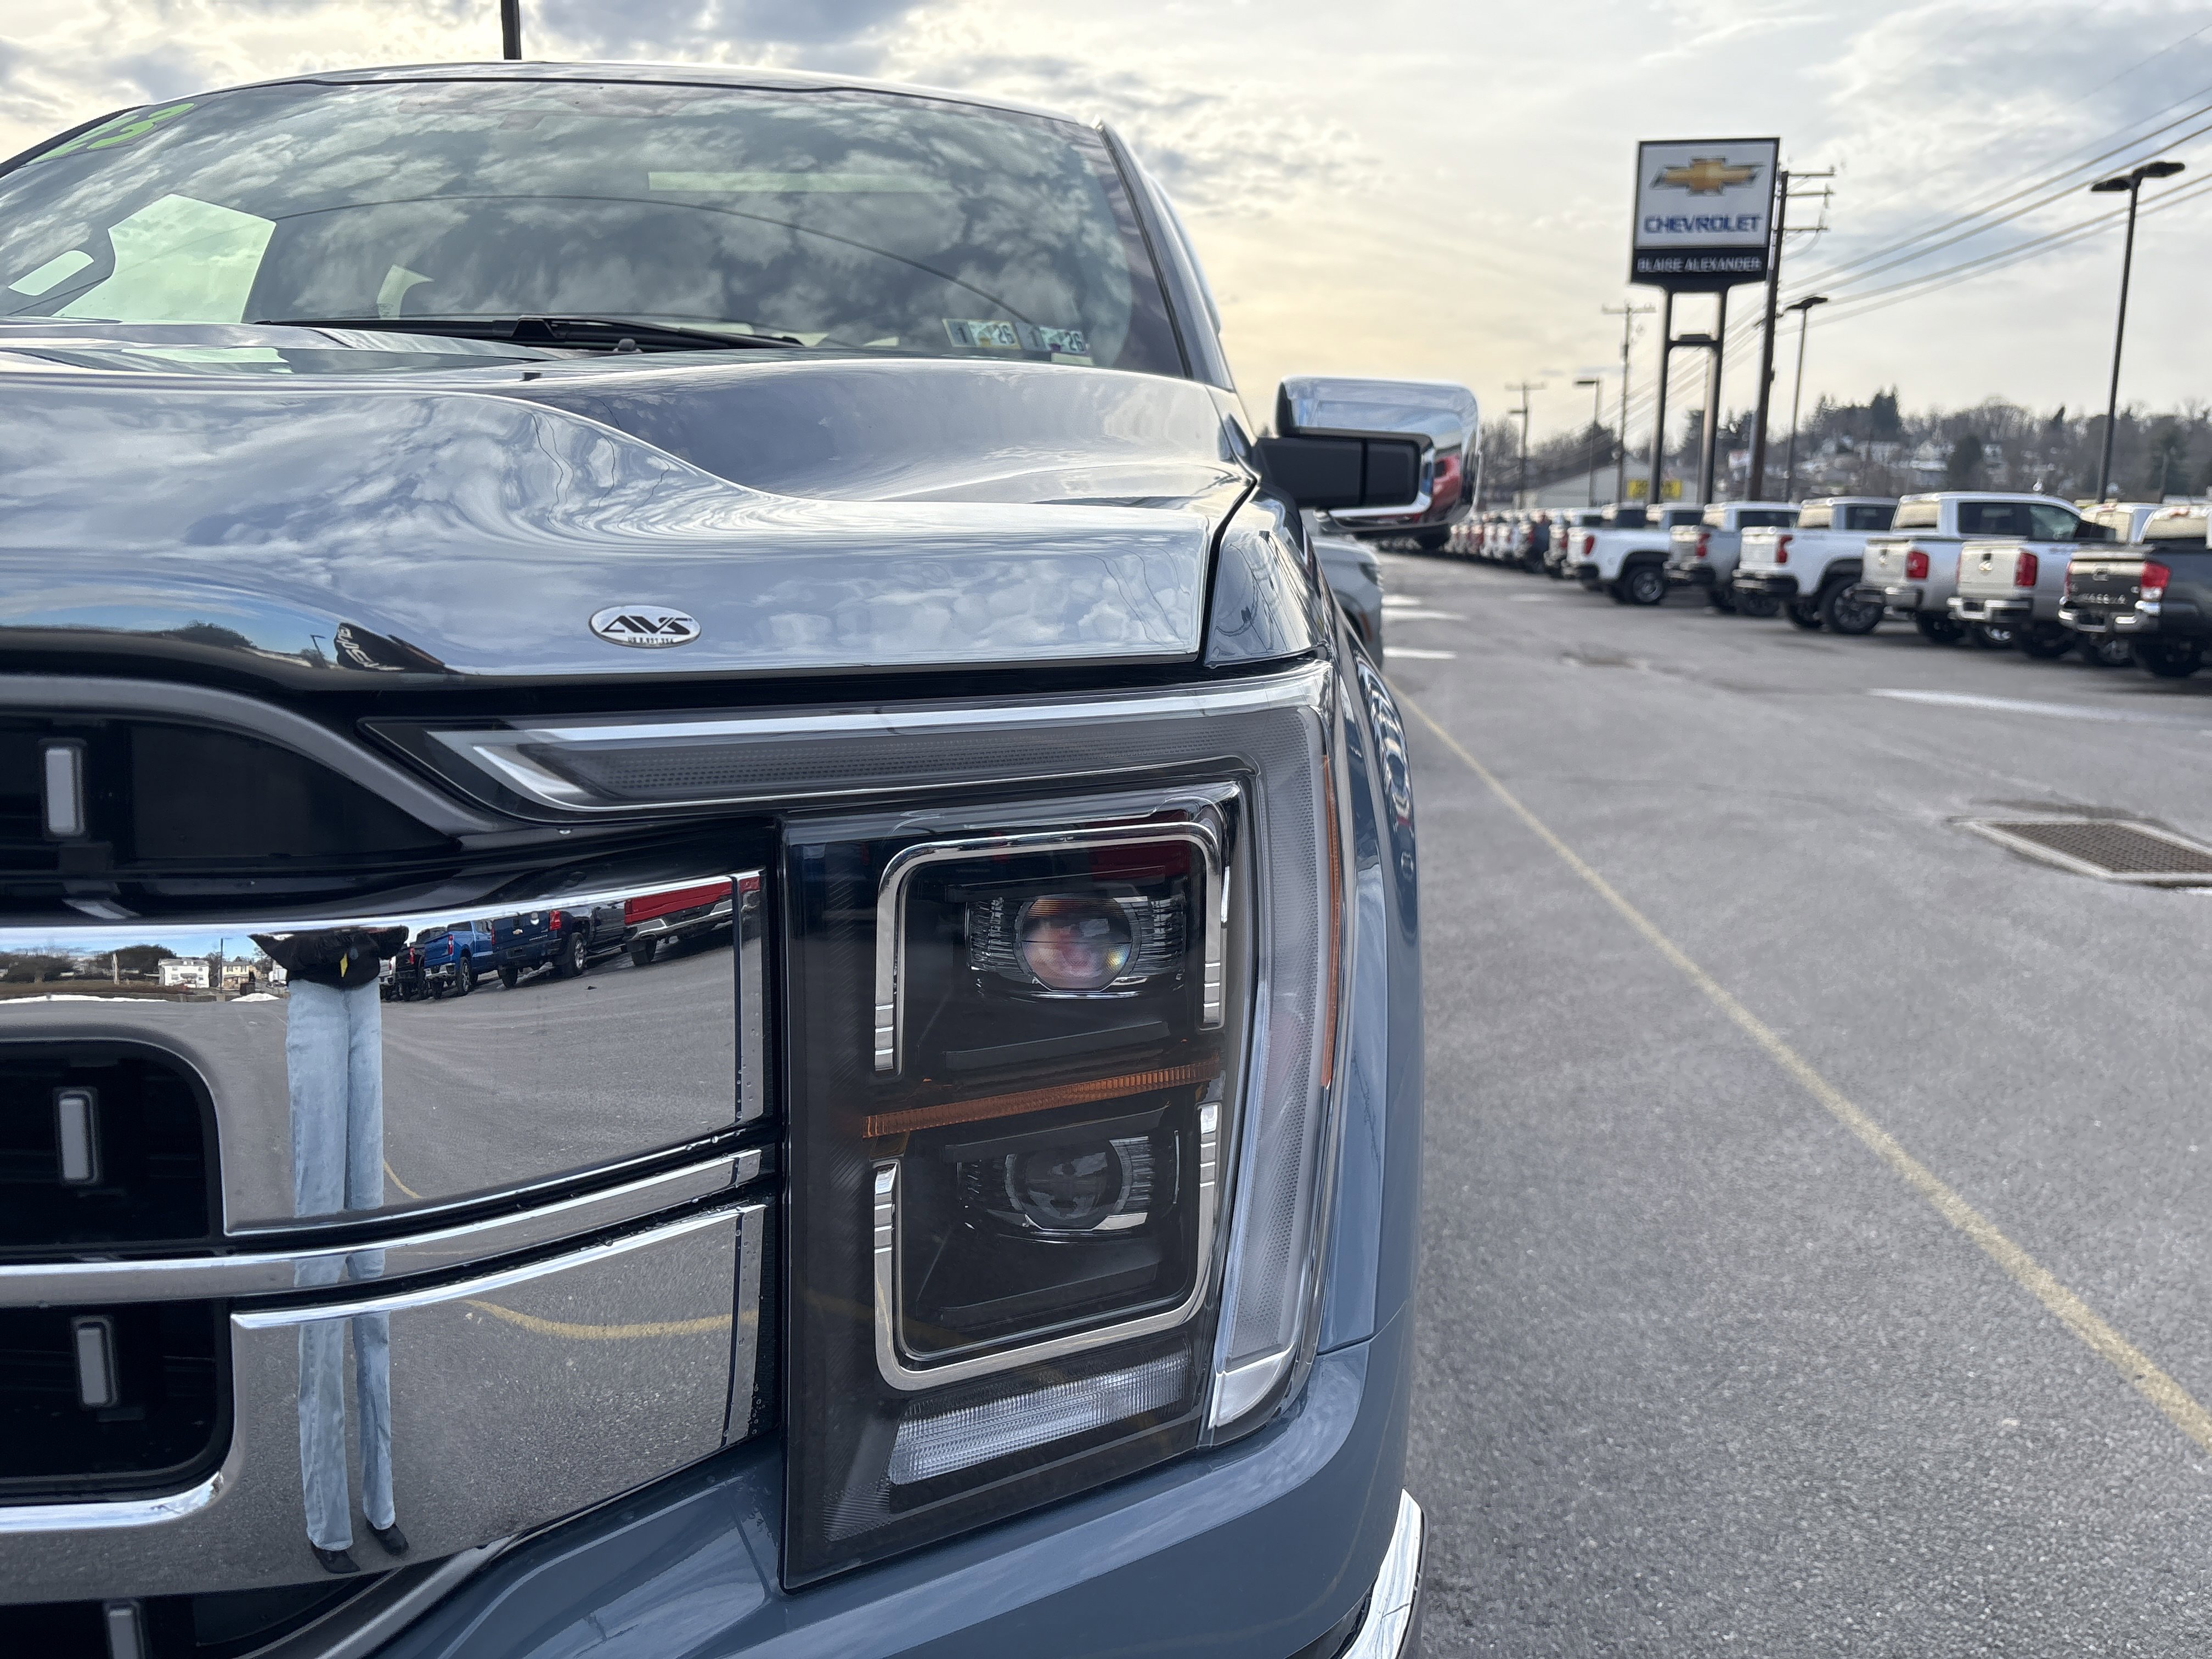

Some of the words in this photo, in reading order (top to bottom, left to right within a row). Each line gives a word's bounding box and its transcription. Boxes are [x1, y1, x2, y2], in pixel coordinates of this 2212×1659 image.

[1645, 215, 1759, 233] CHEVROLET
[1637, 258, 1683, 273] BLAISE
[1684, 257, 1762, 272] ALEXANDER
[601, 615, 691, 635] AVS
